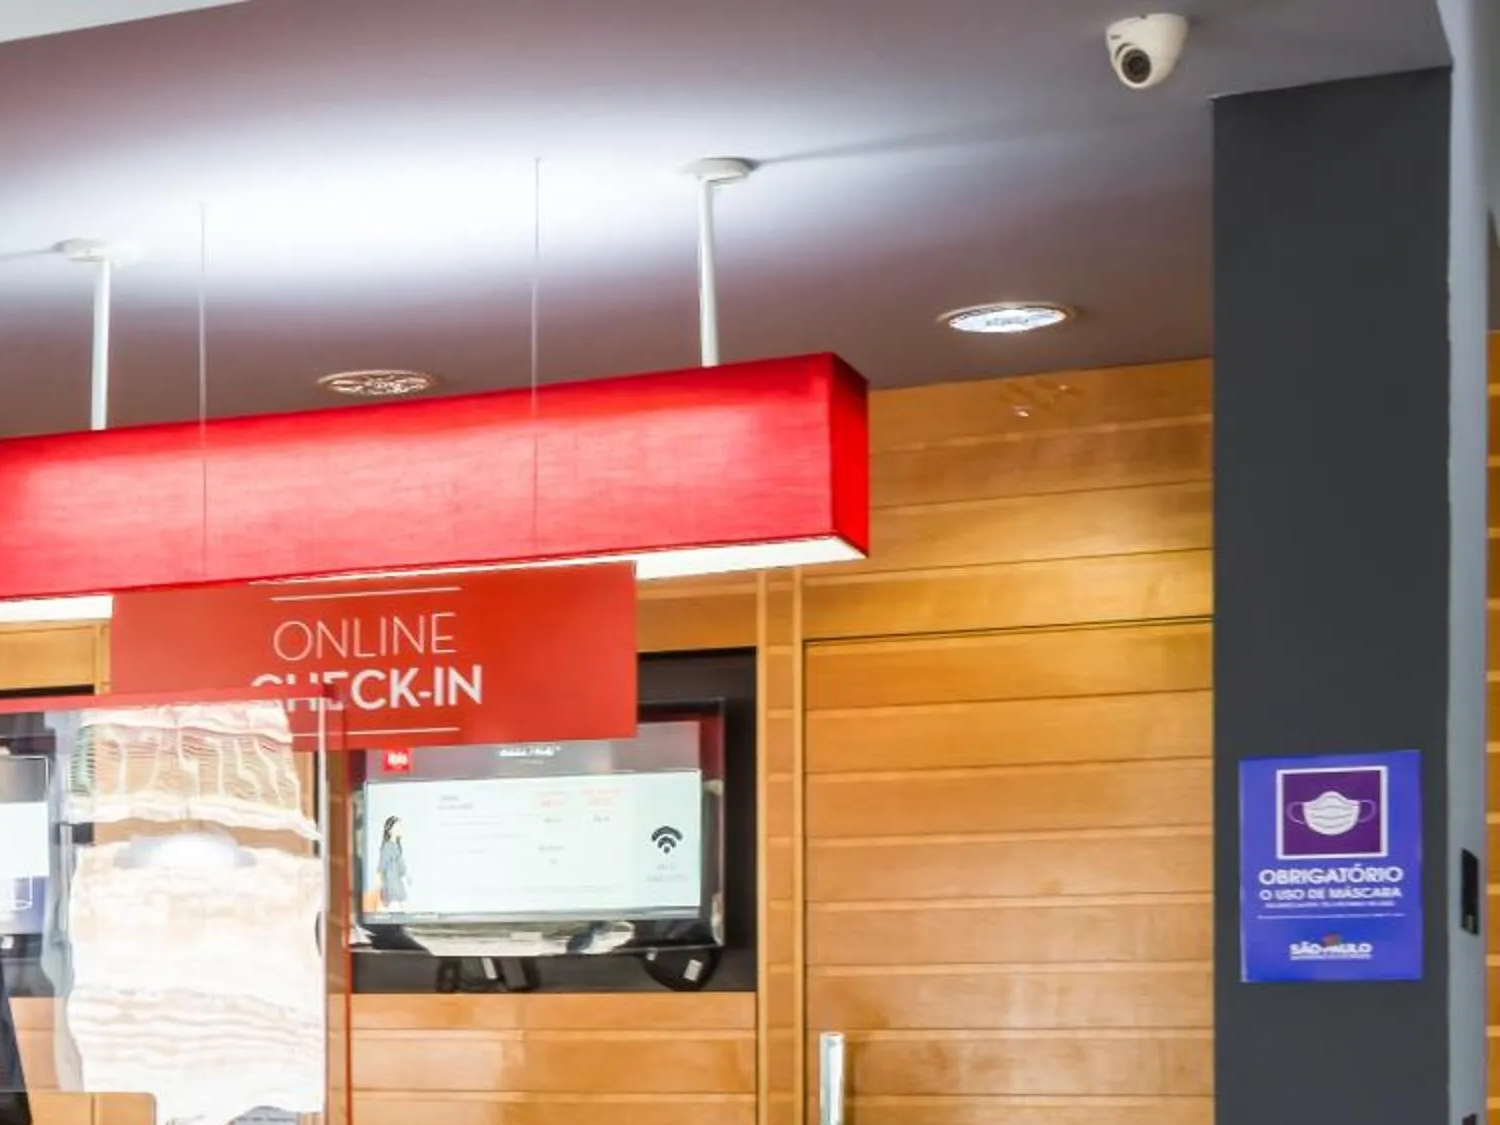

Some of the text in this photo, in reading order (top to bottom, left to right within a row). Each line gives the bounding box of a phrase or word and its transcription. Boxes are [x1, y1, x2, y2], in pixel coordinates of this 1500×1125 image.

[272, 612, 457, 662] ONLINE
[1258, 863, 1404, 885] OBRIGATÓRIO
[1259, 886, 1402, 901] O USO DE MÁSCARA
